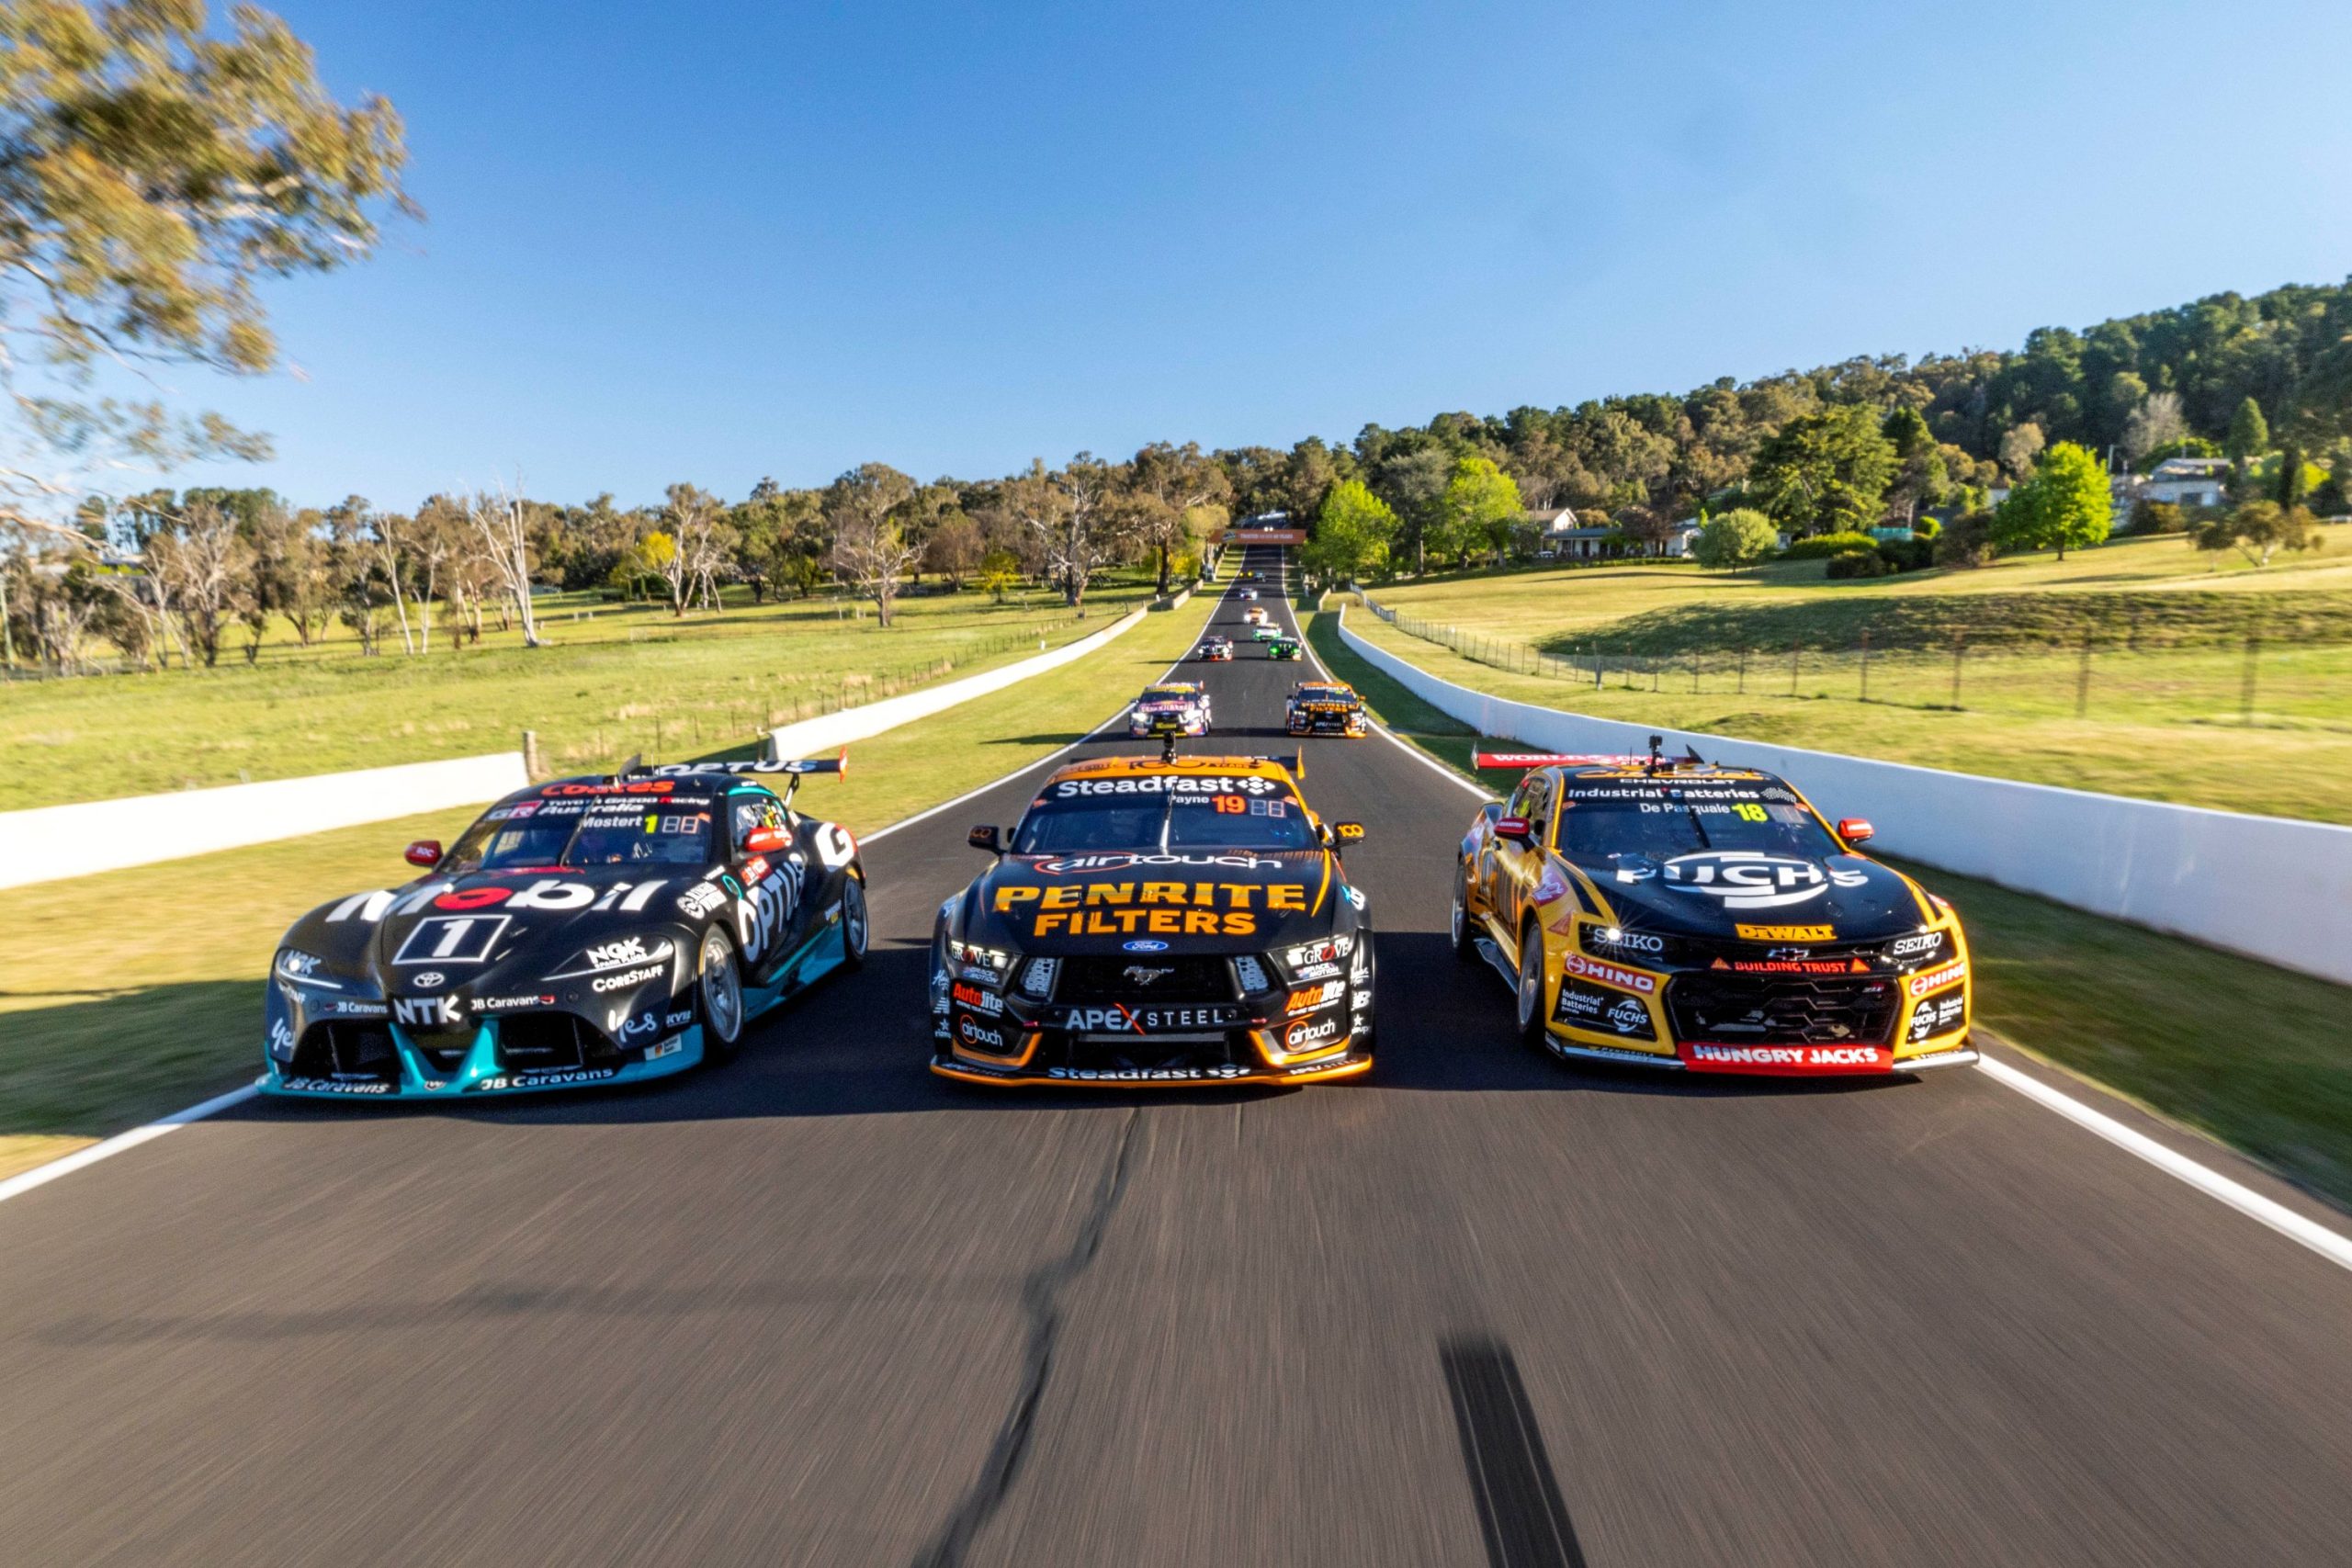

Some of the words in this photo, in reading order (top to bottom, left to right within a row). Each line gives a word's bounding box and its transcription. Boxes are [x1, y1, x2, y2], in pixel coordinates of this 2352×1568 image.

[655, 761, 818, 776] OPTUS
[541, 781, 675, 795] Coates
[1057, 776, 1234, 797] Steadfast
[1568, 788, 1664, 798] Industrial
[1669, 789, 1758, 798] Batteries
[537, 804, 645, 816] Australia
[604, 796, 658, 805] GAZOO
[1169, 795, 1210, 805] Payne
[1212, 795, 1246, 814] 19
[1641, 803, 1660, 813] De
[1664, 804, 1730, 816] Pasquale
[1732, 804, 1768, 822] 18
[582, 815, 643, 829] Mostert
[644, 814, 659, 834] 1
[1047, 853, 1283, 872] airtouch
[325, 879, 669, 922] Mobil
[993, 883, 1306, 912] PENRITE
[1034, 910, 1256, 937] FILTERS
[431, 919, 475, 957] 1
[1894, 931, 1942, 955] SEIKO
[586, 937, 645, 966] NGK
[951, 945, 991, 967] GROVE
[1305, 938, 1349, 964] GROVE
[1735, 961, 1800, 972] BUILDING
[1803, 962, 1846, 973] TRUST
[1587, 963, 1654, 991] HINO
[470, 998, 485, 1010] JB
[487, 996, 540, 1009] Caravans
[954, 983, 1003, 1013] Autolite
[1284, 980, 1346, 1012] Autolite
[1562, 988, 1600, 1007] Industrial
[336, 1001, 347, 1013] JB
[348, 1001, 388, 1015] Caravans
[392, 995, 462, 1026] NTK
[1561, 998, 1598, 1014] Batteries
[1066, 1009, 1141, 1031] APEX
[1148, 1010, 1224, 1027] STEEL
[1608, 1008, 1648, 1024] FUCHS
[1910, 1010, 1937, 1028] FUCHS
[962, 1022, 1003, 1046] airtouch
[1289, 1019, 1336, 1045] airtouch
[1693, 1045, 1804, 1064] HUNGRY
[1809, 1048, 1879, 1064] JACK'S
[481, 1078, 507, 1090] JB
[512, 1067, 614, 1086] Caravans
[1048, 1067, 1201, 1080] Steadfast
[307, 1078, 389, 1094] Caravans
